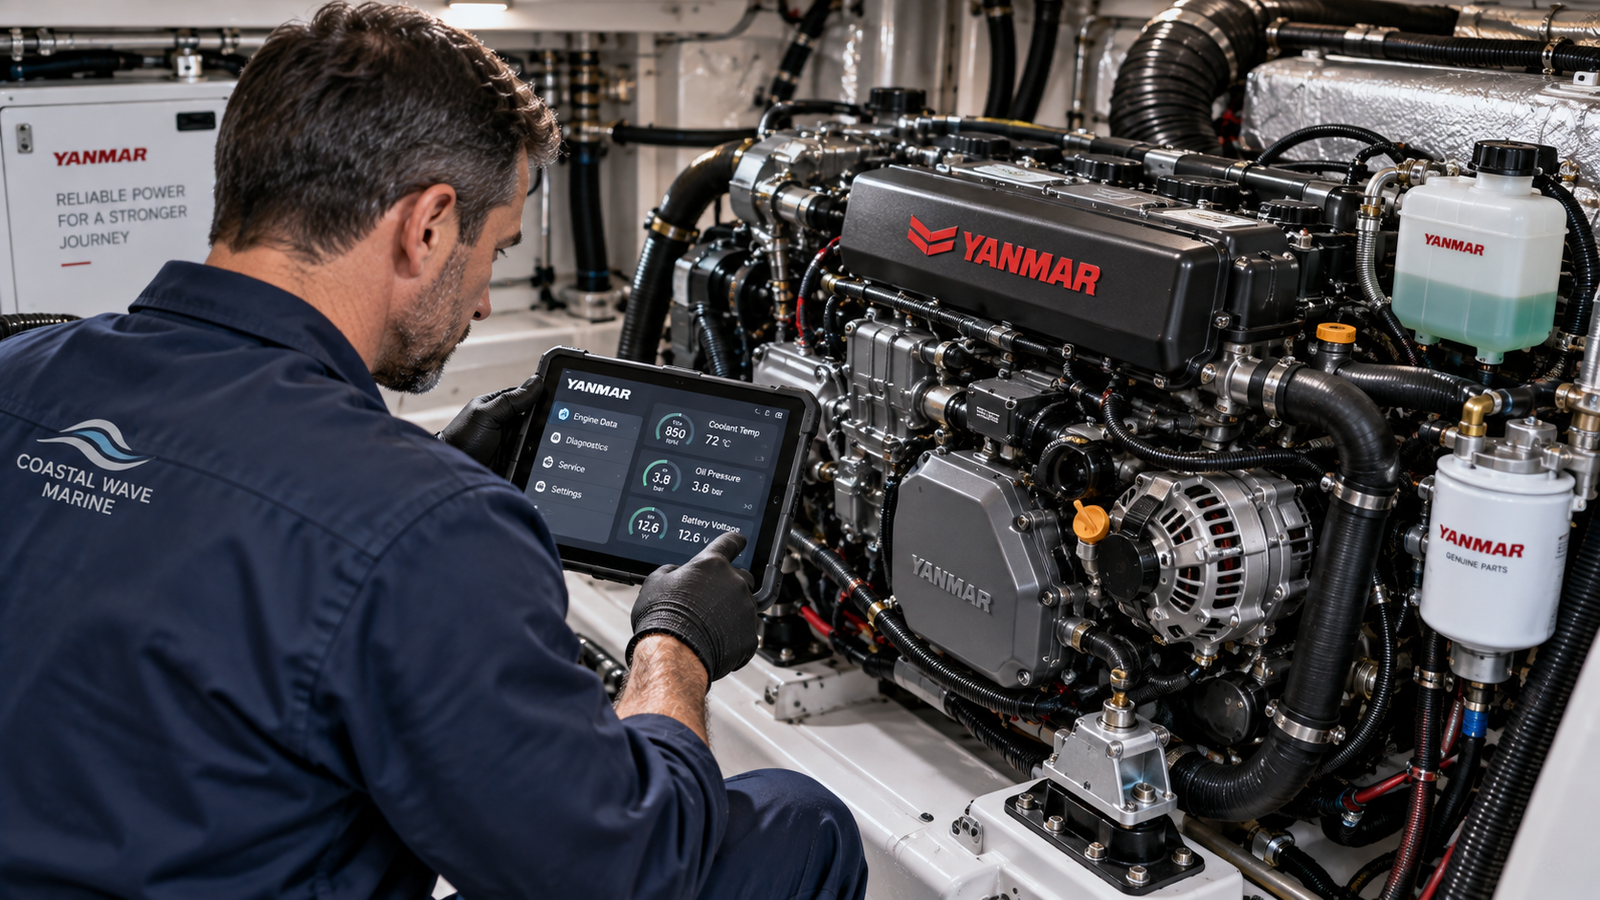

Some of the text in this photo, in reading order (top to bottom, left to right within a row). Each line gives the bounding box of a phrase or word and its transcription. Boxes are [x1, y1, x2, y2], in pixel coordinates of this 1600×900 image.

[53, 147, 148, 167] YANMAR
[56, 184, 186, 207] RELIABLE POWER
[58, 204, 188, 228] FOR A STRONGER
[59, 230, 130, 250] JOURNEY
[1424, 233, 1485, 256] YANMAR
[963, 231, 1101, 296] YANMAR
[567, 378, 632, 400] YANMAR
[573, 412, 618, 429] Engine Data
[708, 420, 761, 438] Coolant Temp
[665, 426, 686, 439] 850
[705, 434, 720, 447] 72
[565, 436, 608, 452] Diagnostics
[558, 460, 586, 474] Service
[695, 467, 742, 483] Oil Pressure
[16, 453, 153, 504] COASTAL WAVE
[652, 472, 671, 485] 3.8
[551, 485, 582, 500] Settings
[691, 481, 724, 497] 3.8 bar
[41, 482, 116, 515] MARINE
[638, 519, 660, 534] 12.6
[681, 514, 711, 529] Battery
[678, 529, 701, 544] 12.6
[1439, 523, 1525, 559] YANMAR
[1445, 551, 1509, 574] GENUINE PARTS
[911, 553, 992, 613] YANMAR
